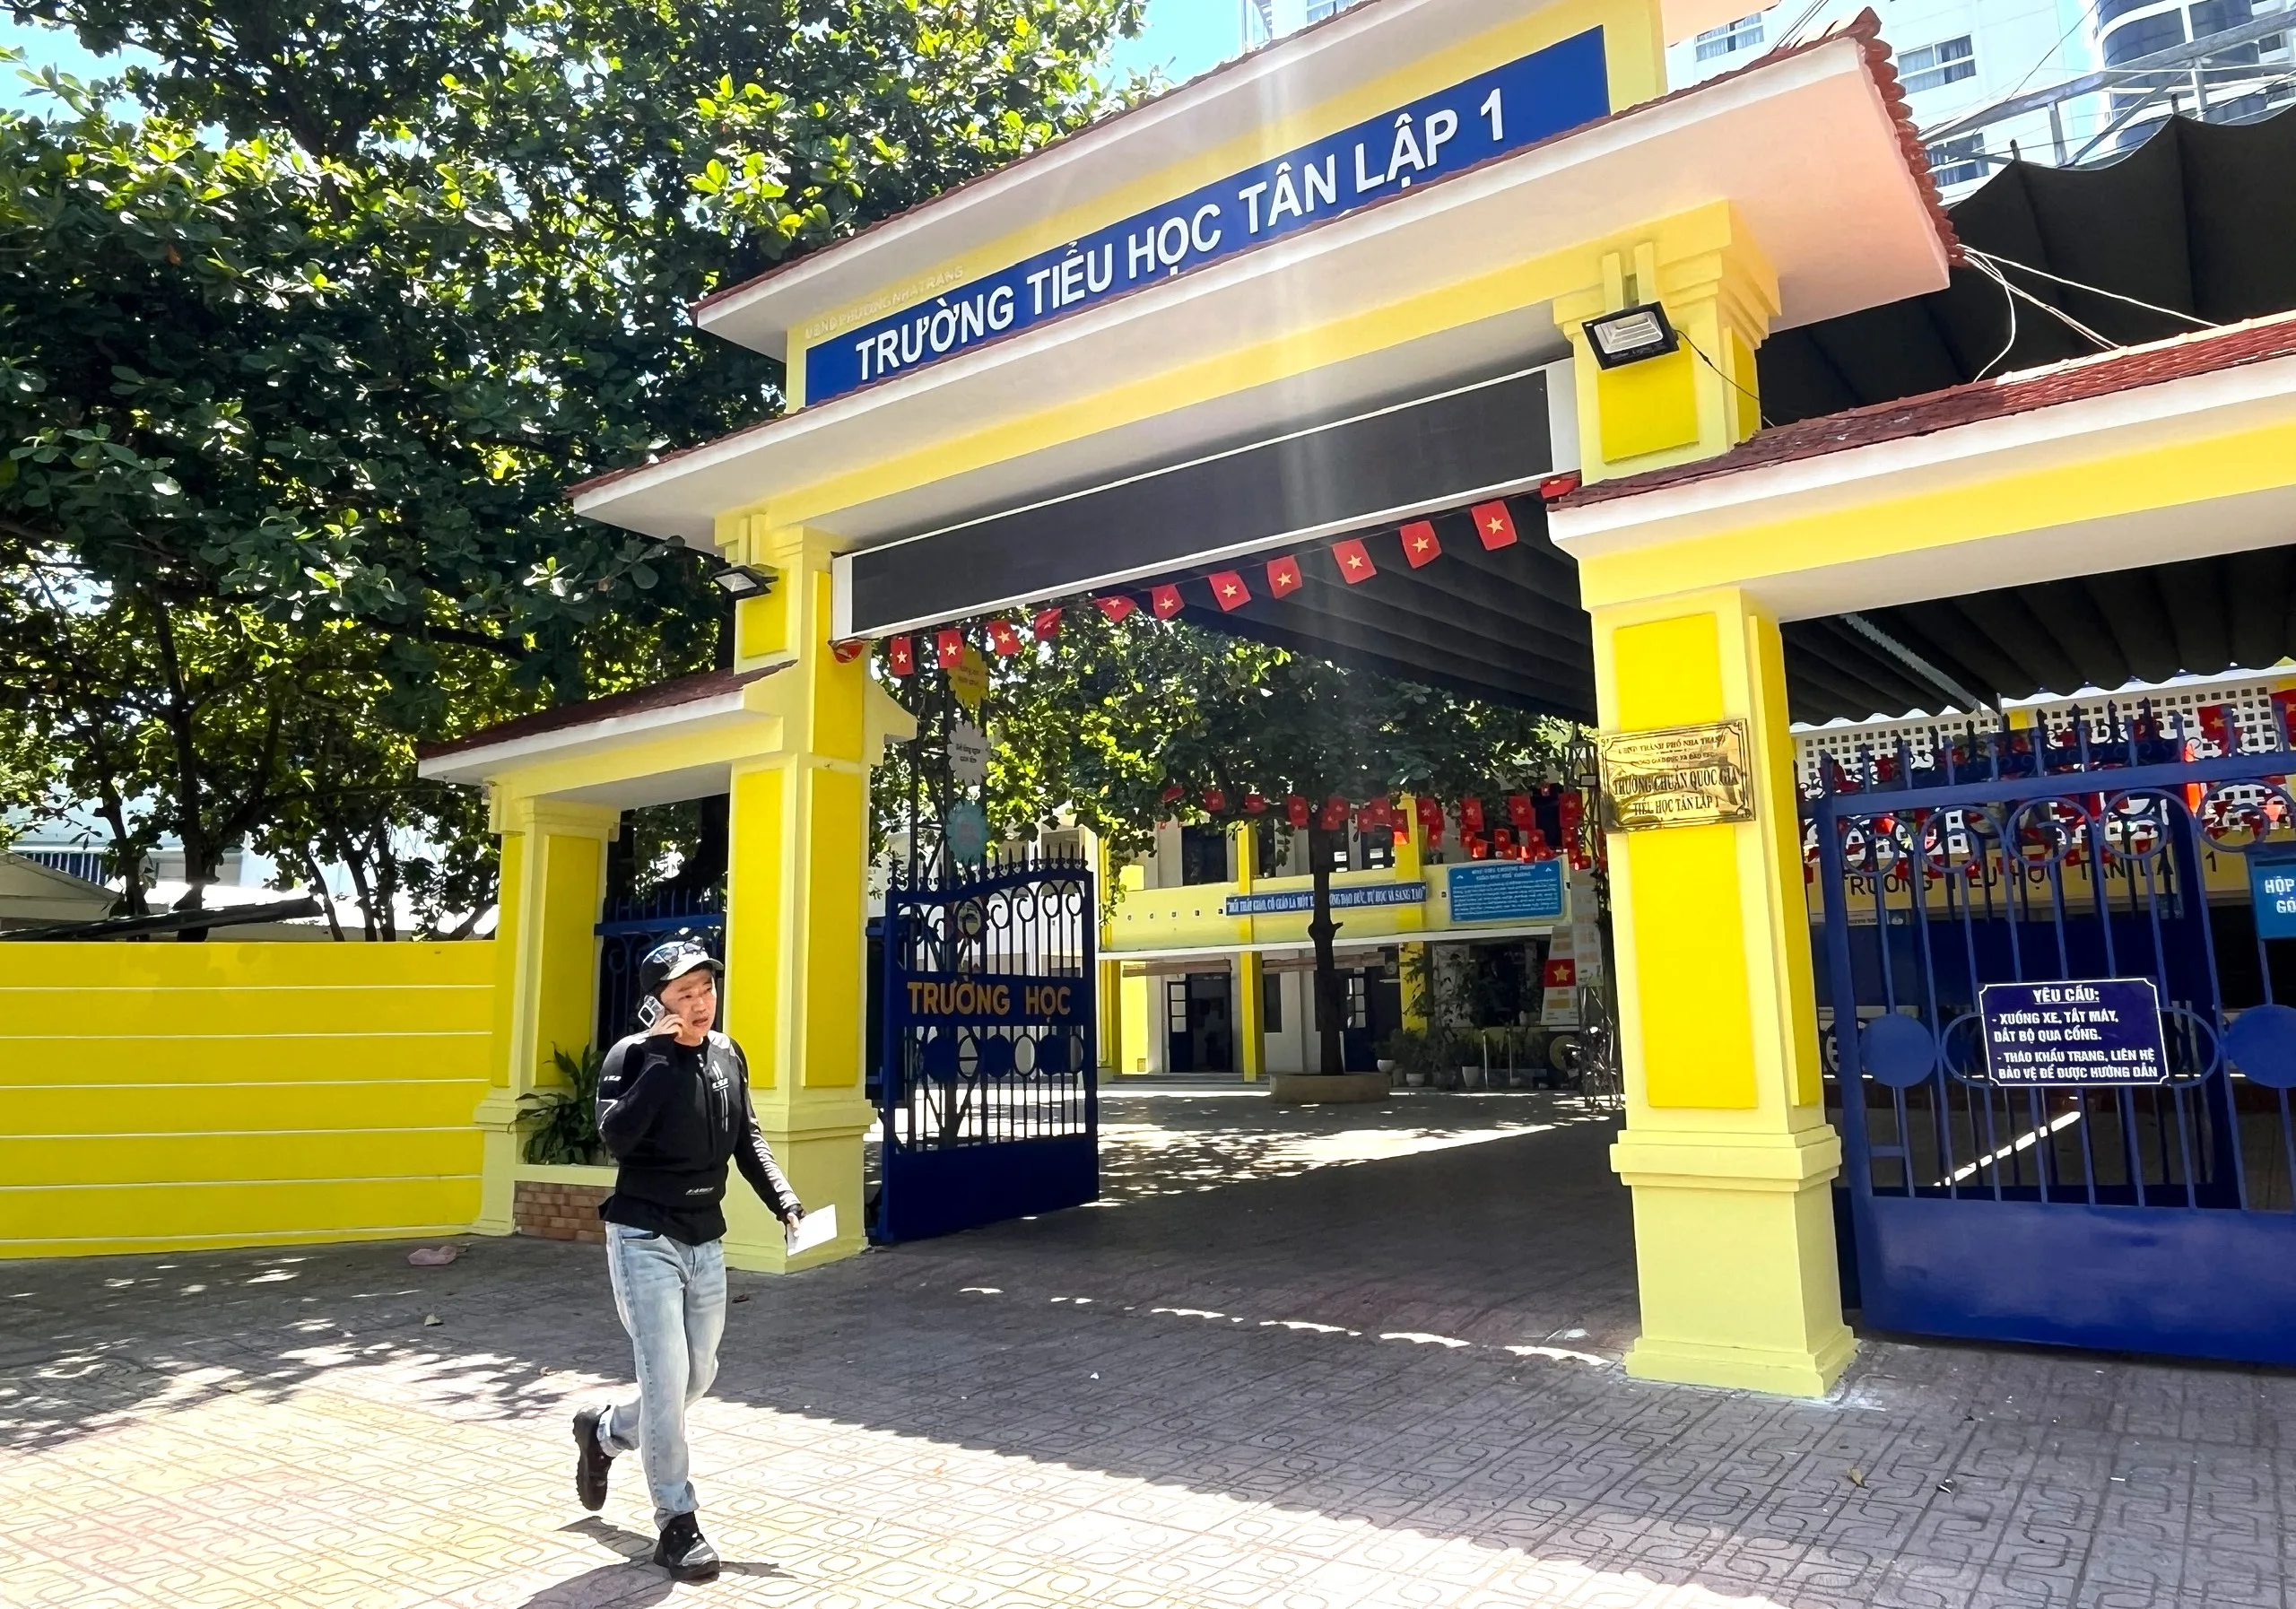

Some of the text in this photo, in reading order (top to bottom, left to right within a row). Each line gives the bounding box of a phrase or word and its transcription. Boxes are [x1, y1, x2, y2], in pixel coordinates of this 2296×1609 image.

[856, 87, 1503, 380] TRƯỜNG TIỂU HỌC TÂN LẬP 1
[2265, 875, 2296, 896] HỘP
[907, 974, 1071, 1023] TRƯỜNG HỌC
[2032, 987, 2061, 1004] YÊU
[2019, 1028, 2035, 1044] BỘ
[2038, 1030, 2062, 1042] QUA
[2110, 1048, 2137, 1061] LIÊN
[2139, 1048, 2155, 1063] HỆ
[2022, 1065, 2038, 1081] VỆ
